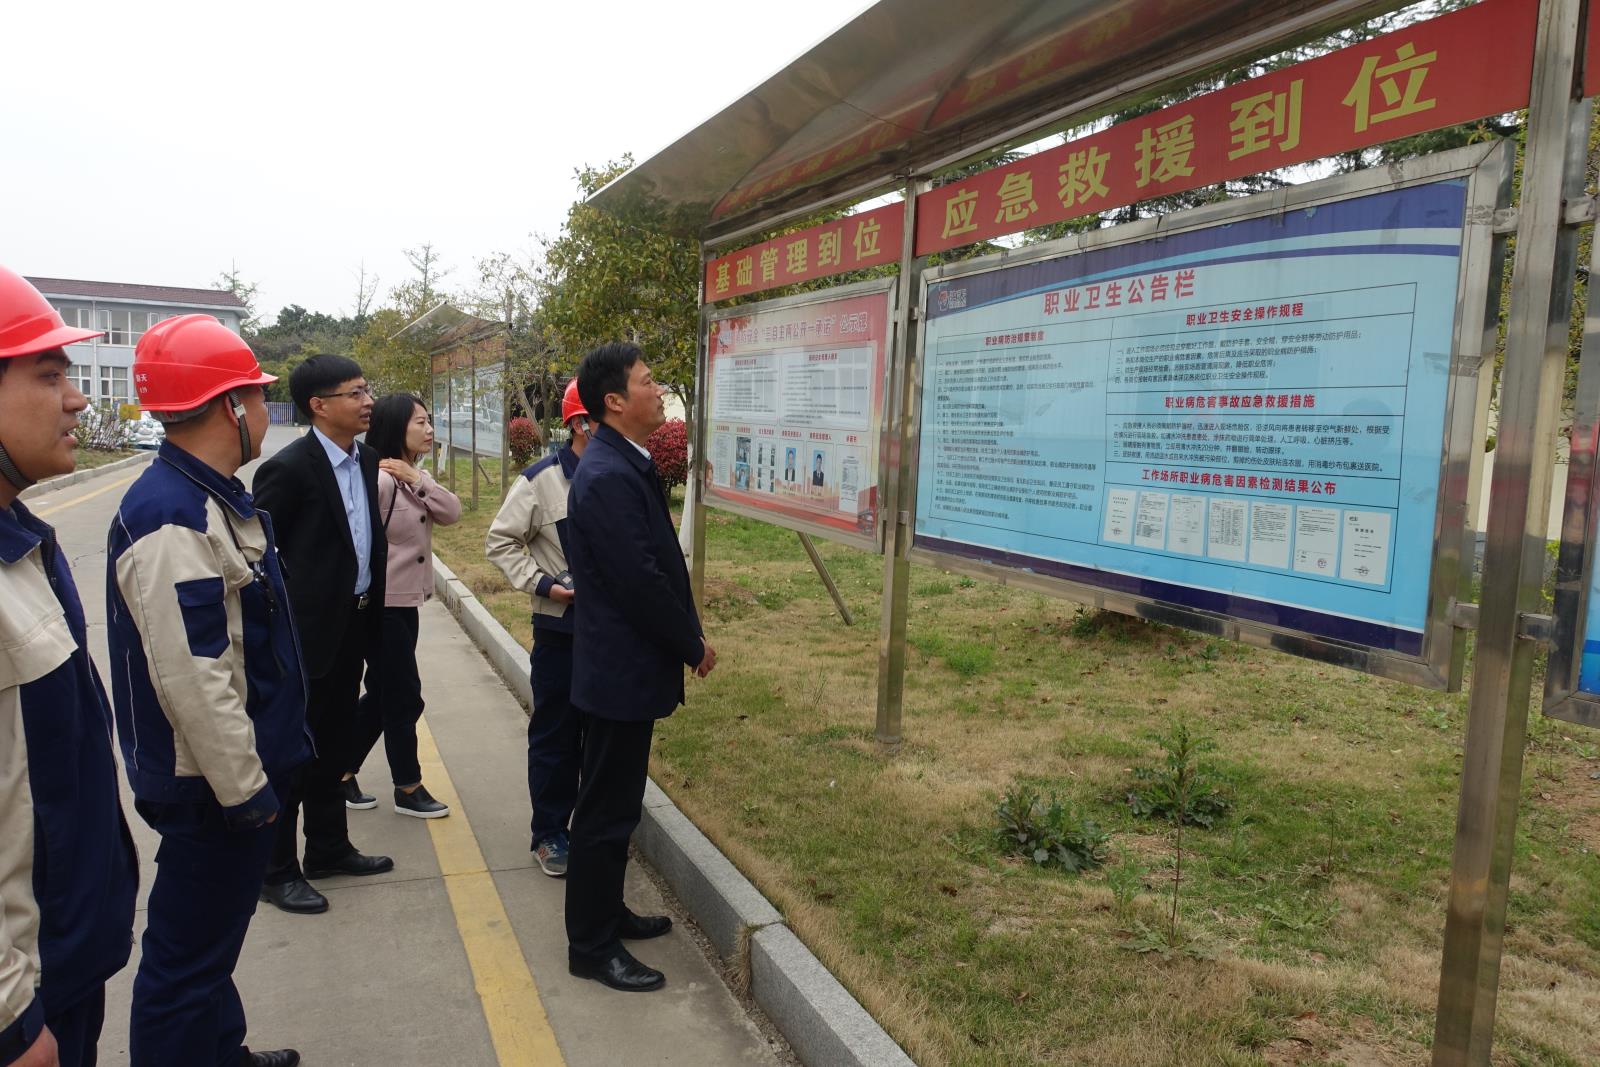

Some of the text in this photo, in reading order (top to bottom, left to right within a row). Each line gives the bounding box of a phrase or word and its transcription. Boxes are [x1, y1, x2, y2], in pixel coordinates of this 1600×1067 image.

[941, 41, 1439, 241] 应急救援到位
[716, 217, 881, 294] 基础管理到位
[1043, 269, 1195, 316] 职业卫生公告栏
[1186, 302, 1304, 327] 职业卫生安全操作规程
[985, 331, 1044, 346] 职业病防治规章制度
[1165, 394, 1316, 409] 职业病危害事故应急救援措施
[1142, 469, 1337, 495] 工作场所职业病危害因素检测结果公布
